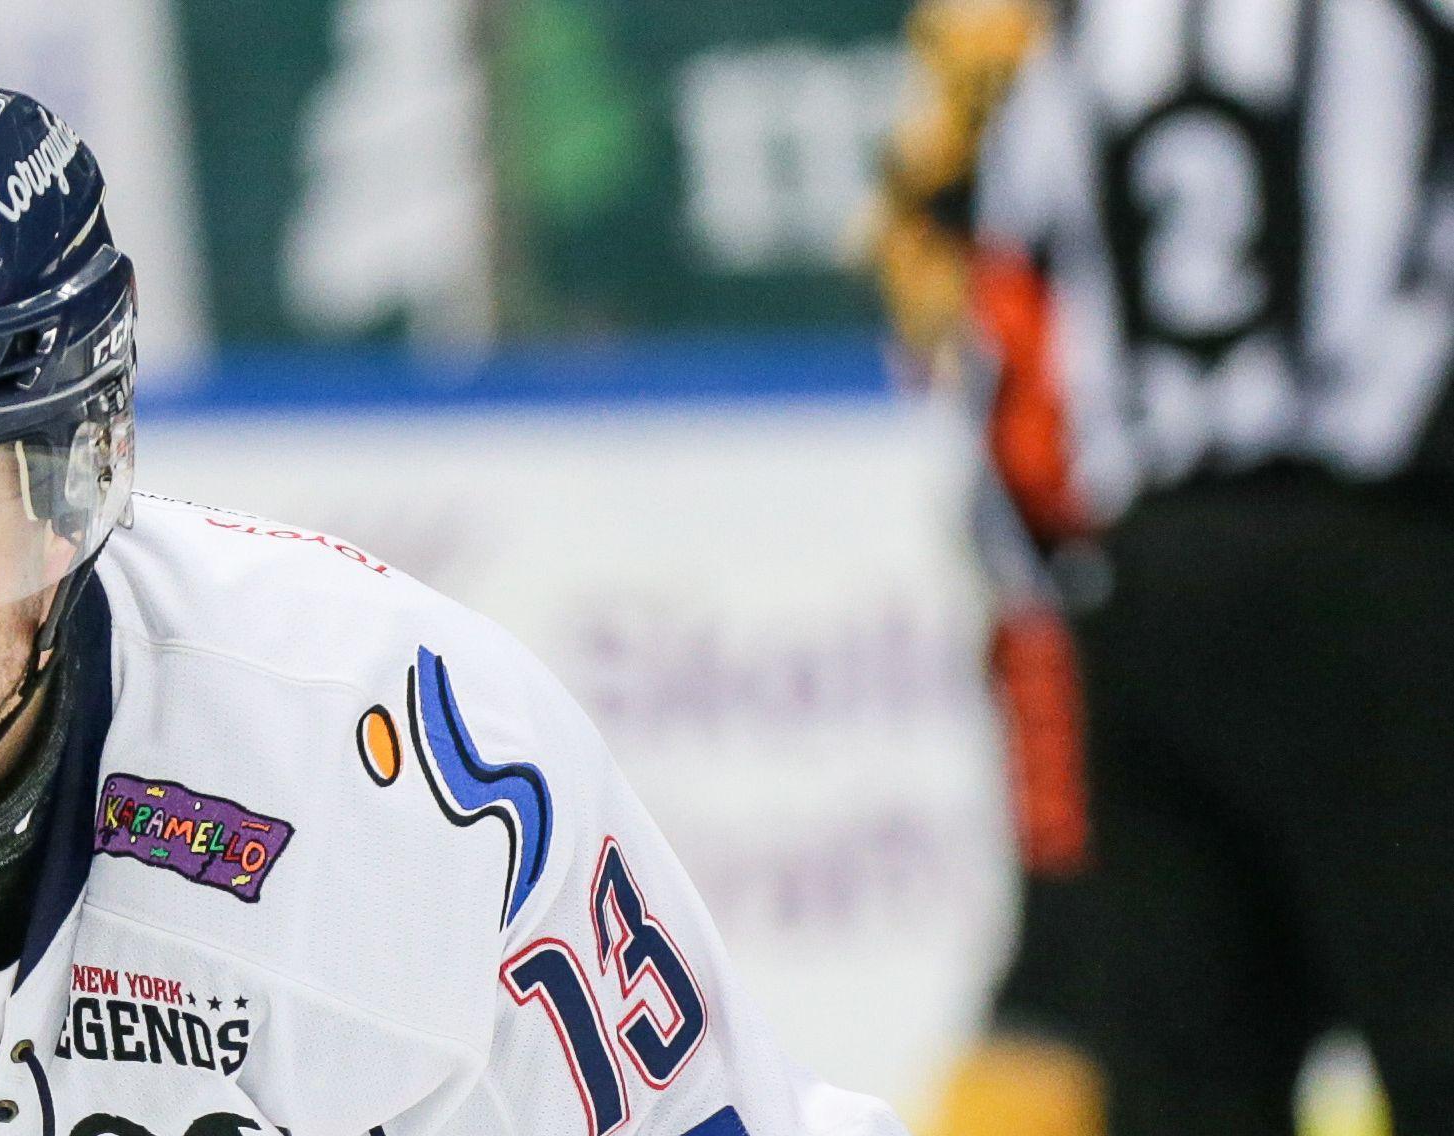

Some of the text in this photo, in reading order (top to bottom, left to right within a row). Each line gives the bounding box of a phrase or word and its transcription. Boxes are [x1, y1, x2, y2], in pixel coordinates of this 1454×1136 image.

[204, 517, 391, 578] TOYOTA
[103, 794, 268, 874] KARAMELLO
[71, 963, 184, 1007] NEW YORK
